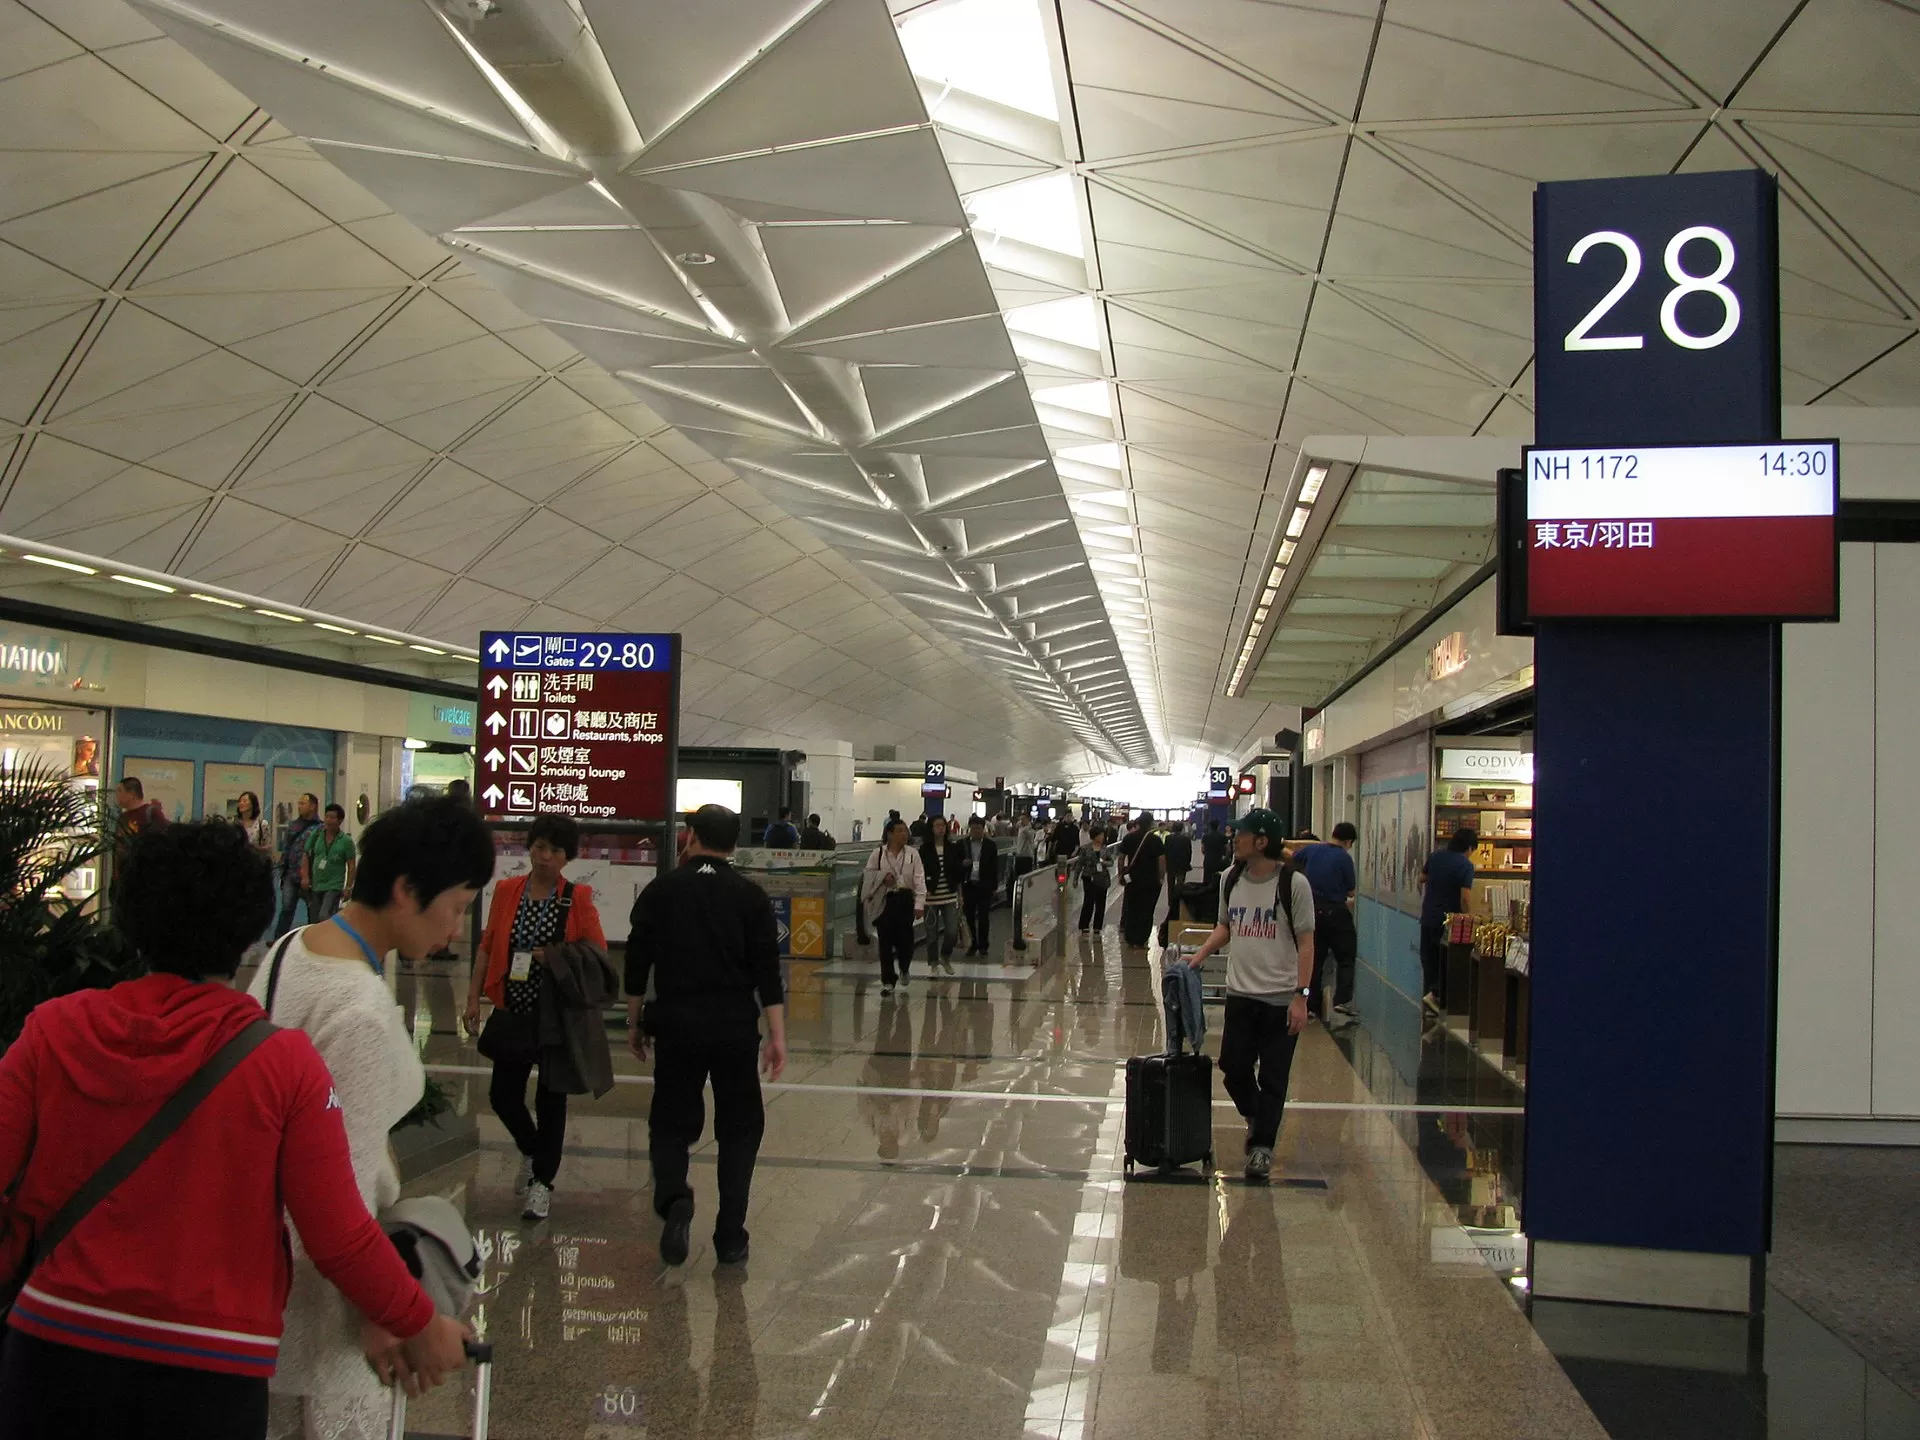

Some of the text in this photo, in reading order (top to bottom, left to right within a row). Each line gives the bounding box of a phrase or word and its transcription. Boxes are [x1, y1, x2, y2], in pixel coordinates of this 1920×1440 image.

[1564, 225, 1741, 352] 28
[1533, 450, 1828, 480] NH 1172 14:30
[1533, 521, 1654, 550] 東京/羽田
[544, 642, 655, 668] Gates 29-80
[543, 673, 594, 692] 洗手間
[543, 692, 576, 703] Toilets
[574, 710, 658, 730] 餐廳及商店
[573, 730, 664, 744] Restaurants, shops
[540, 747, 591, 765] 吸煙室
[1465, 755, 1526, 768] GODIVA
[540, 766, 626, 781] Smoking lounge
[927, 763, 944, 777] 29
[1211, 770, 1227, 783] 30
[539, 783, 589, 802] 休憩處
[1040, 788, 1049, 797] 31
[1197, 792, 1206, 800] 32
[538, 802, 617, 817] Resting lounge
